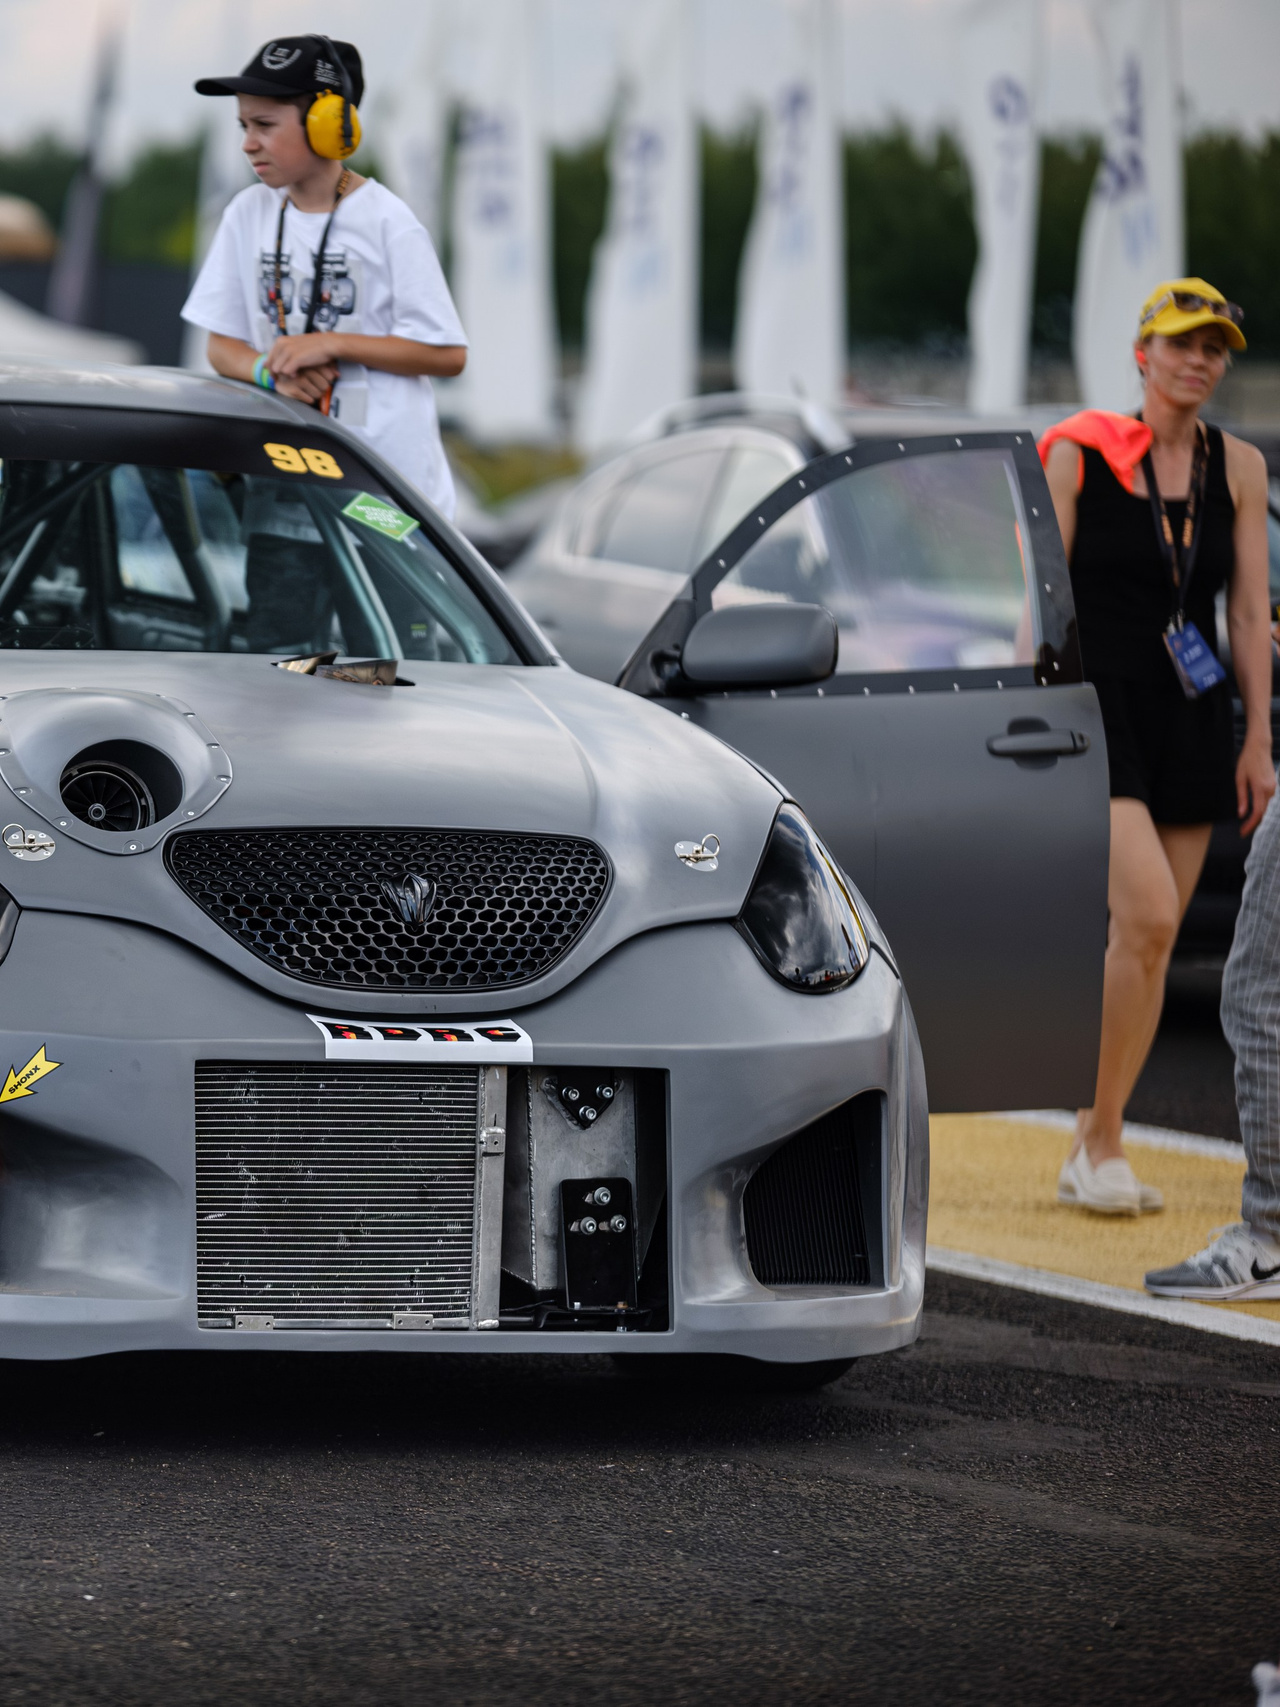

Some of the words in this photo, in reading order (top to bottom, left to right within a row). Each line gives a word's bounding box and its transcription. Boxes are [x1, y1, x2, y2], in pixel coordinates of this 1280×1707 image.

[263, 442, 345, 480] 98
[317, 1020, 522, 1042] RDRC
[8, 1065, 40, 1094] SHONX
